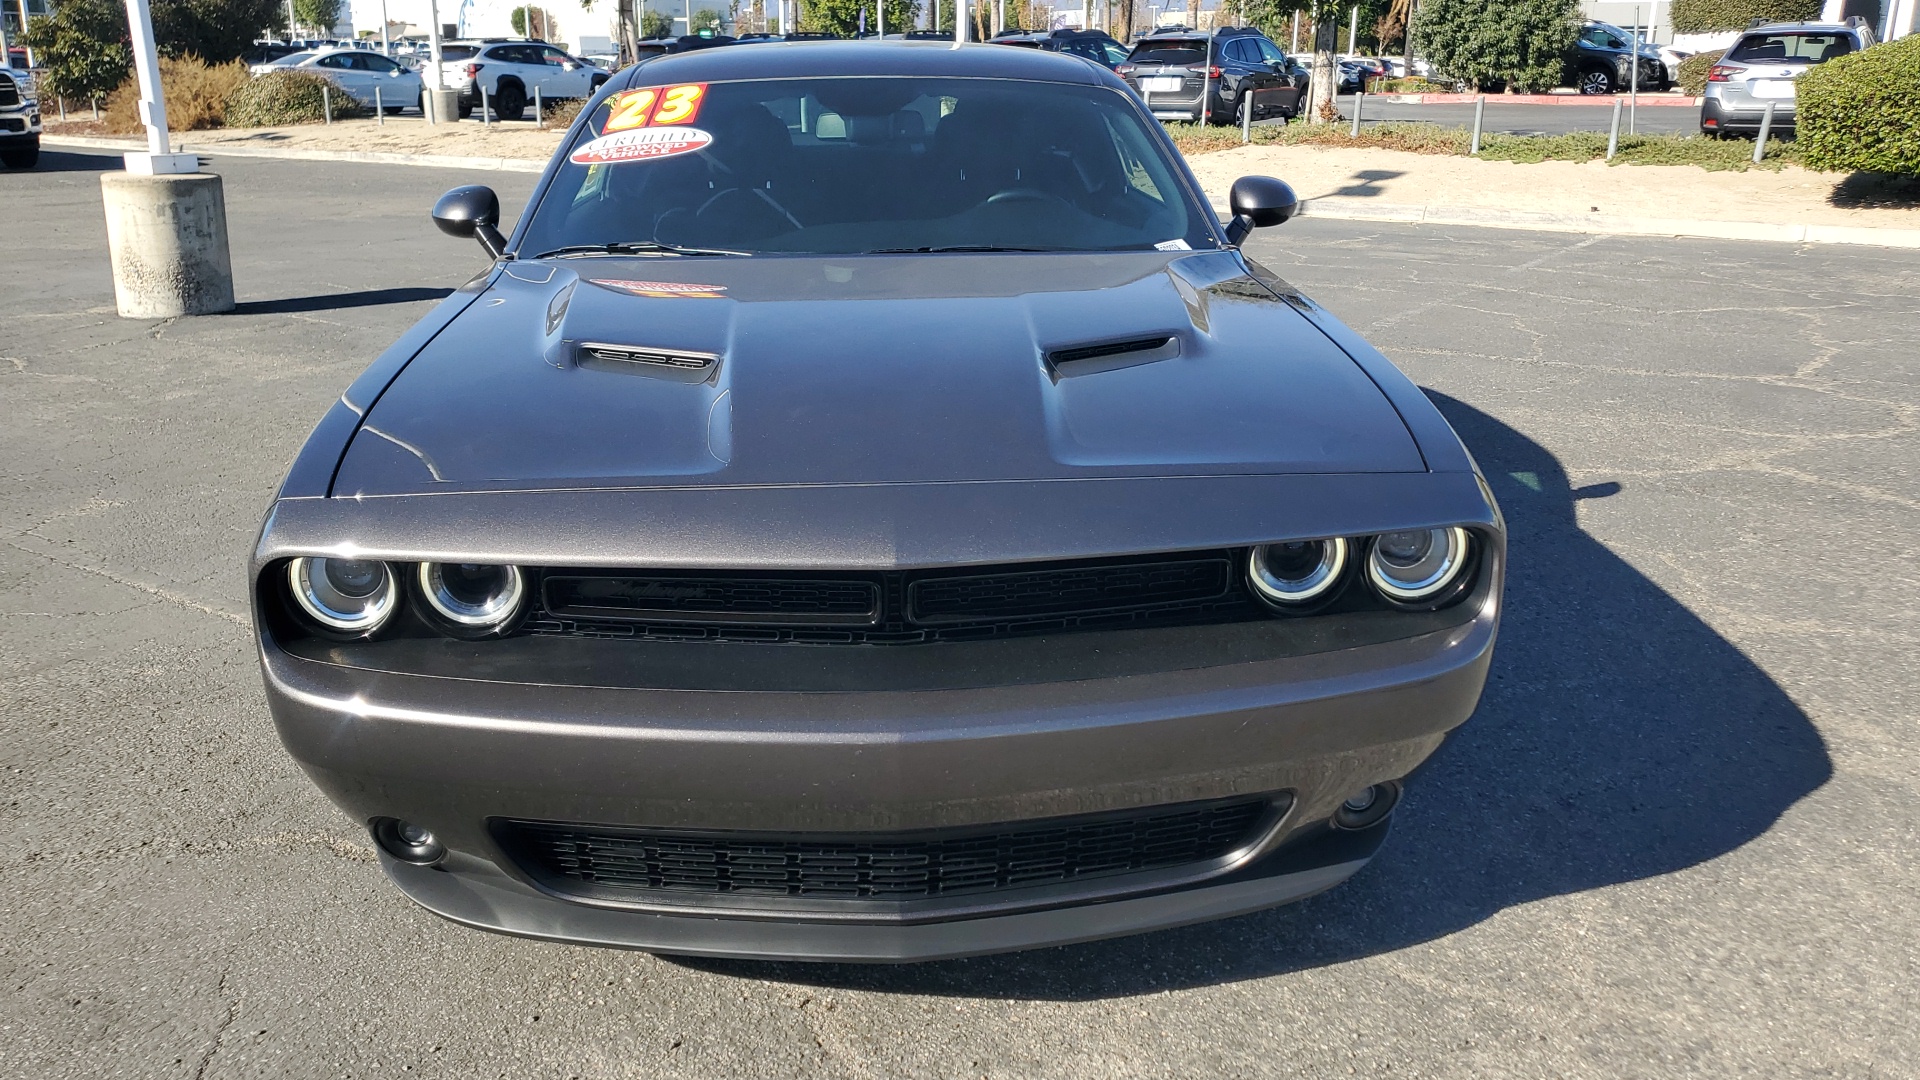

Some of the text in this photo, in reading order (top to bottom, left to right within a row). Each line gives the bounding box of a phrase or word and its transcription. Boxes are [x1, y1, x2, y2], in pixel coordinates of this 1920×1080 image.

[607, 85, 702, 130] 23
[588, 142, 688, 158] PRE-OWNED
[600, 148, 671, 161] VEHICLE
